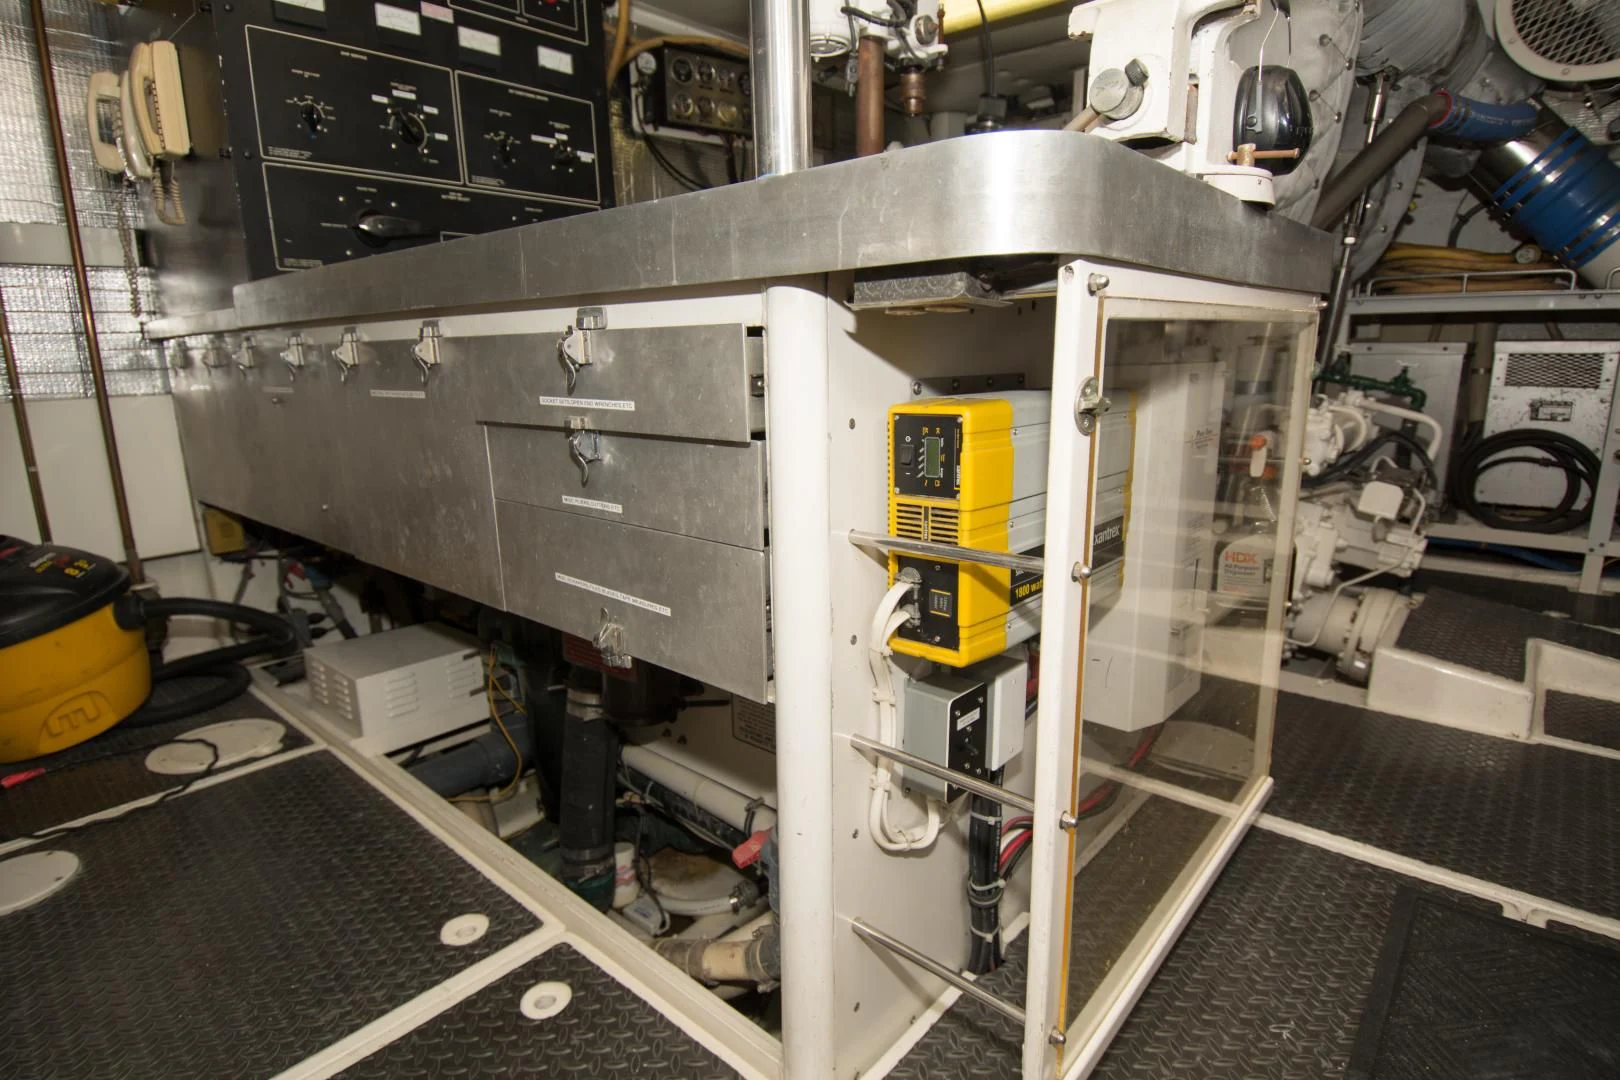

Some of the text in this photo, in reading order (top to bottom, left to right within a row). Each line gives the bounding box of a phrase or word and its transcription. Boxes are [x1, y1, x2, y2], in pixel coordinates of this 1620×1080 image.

[1094, 524, 1121, 546] xantrex
[1223, 551, 1257, 564] HDX
[1015, 578, 1044, 600] 1800 wat
